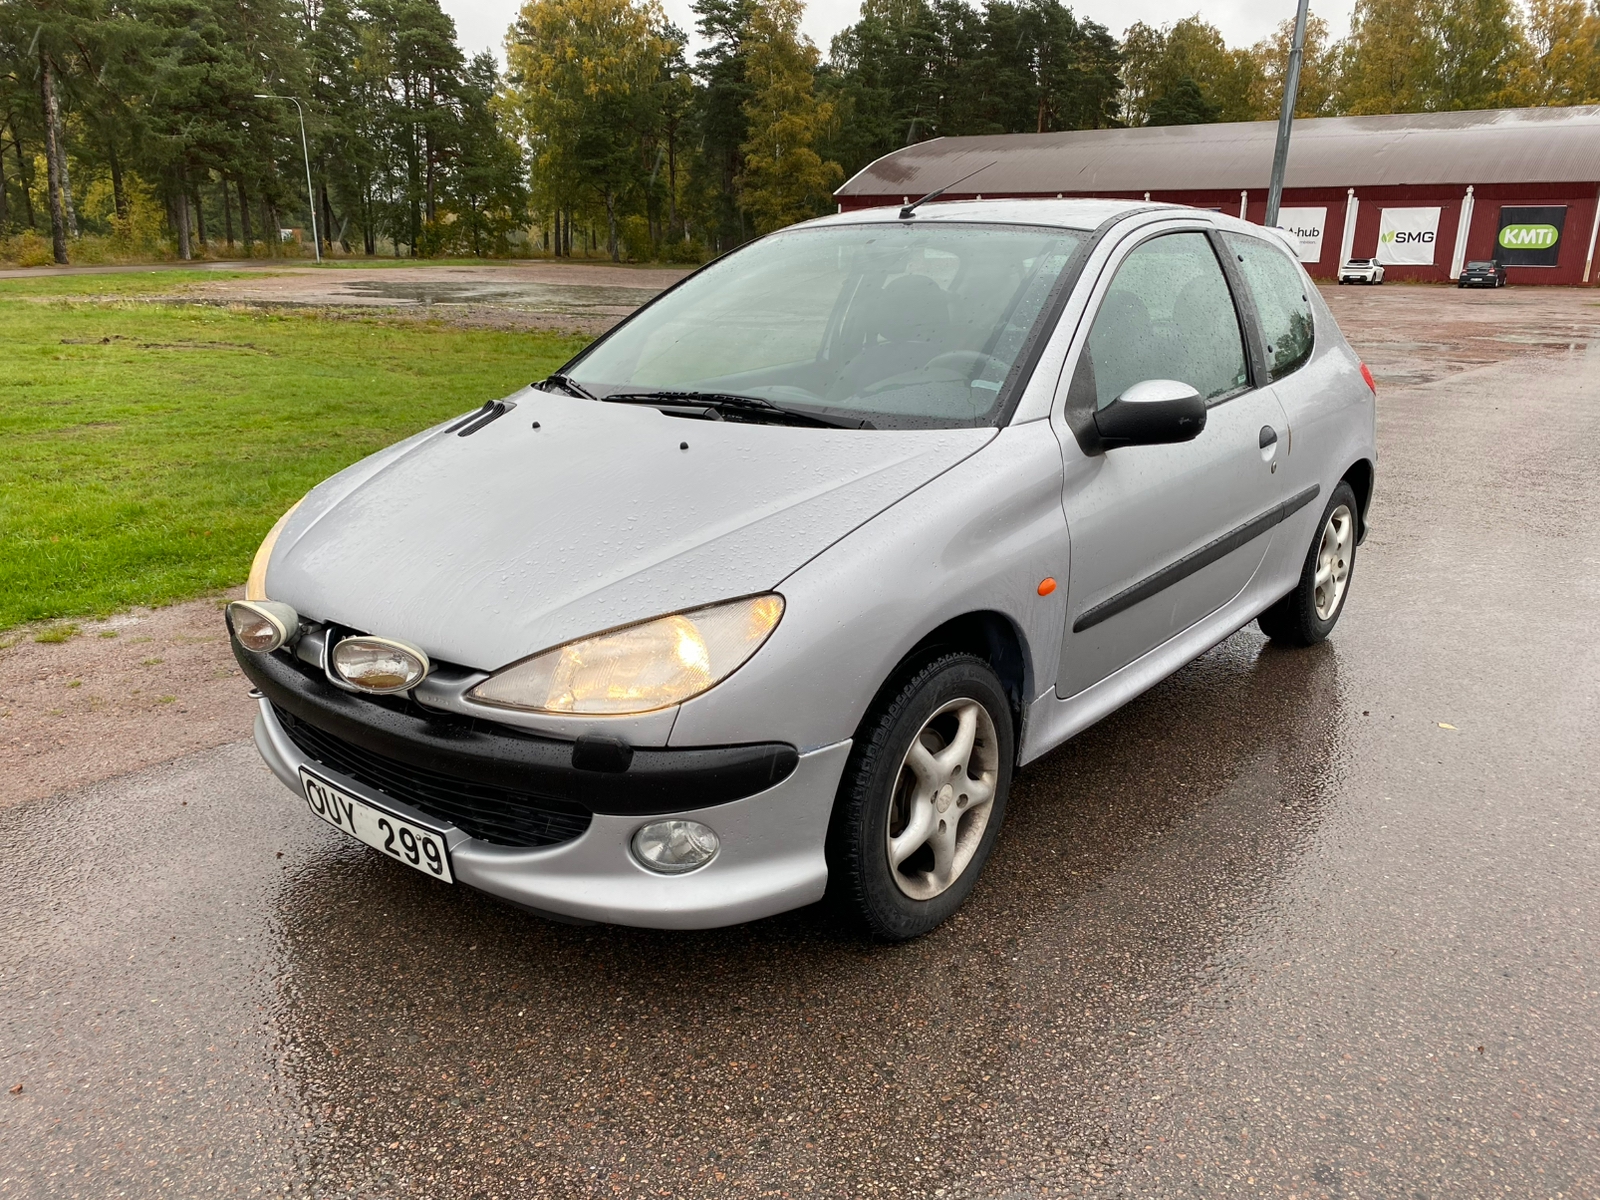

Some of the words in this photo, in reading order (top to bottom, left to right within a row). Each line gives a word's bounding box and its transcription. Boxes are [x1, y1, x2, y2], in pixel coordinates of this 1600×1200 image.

[1395, 231, 1435, 244] SMG
[306, 779, 357, 835] OUY
[378, 817, 443, 876] 299
